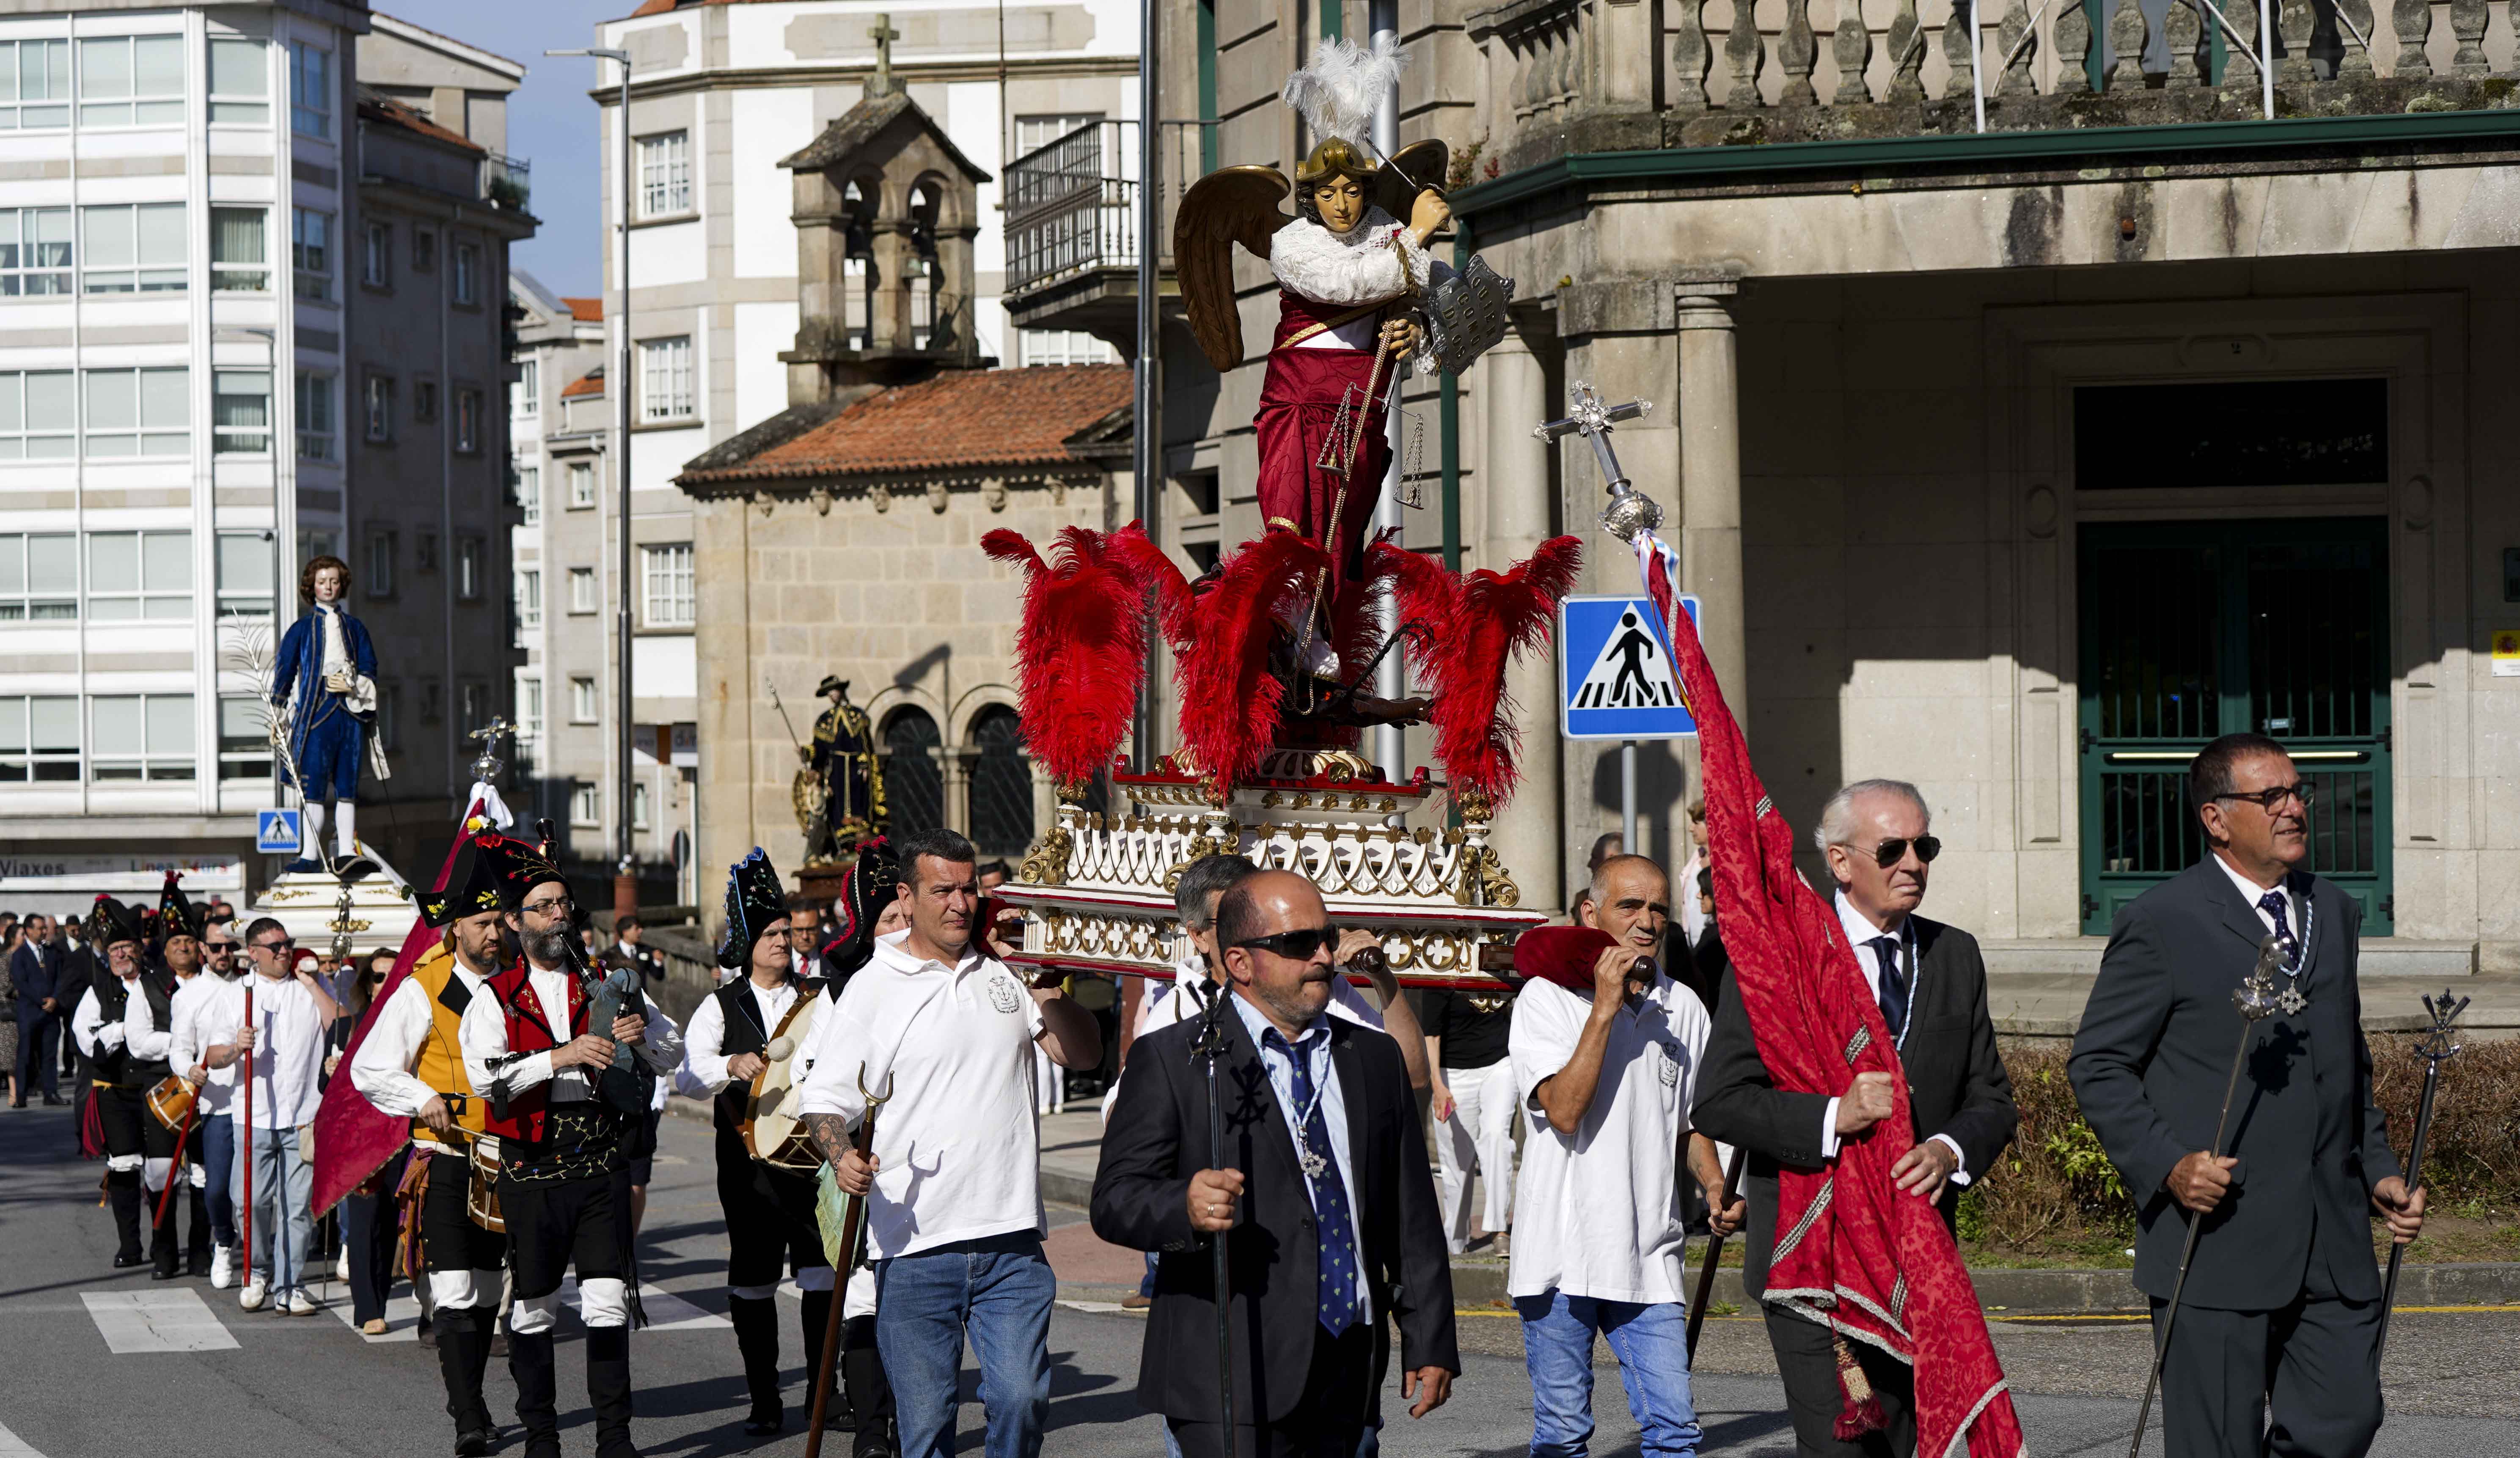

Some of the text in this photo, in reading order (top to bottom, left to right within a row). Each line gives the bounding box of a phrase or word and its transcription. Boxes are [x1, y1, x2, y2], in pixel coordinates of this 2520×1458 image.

[1442, 306, 1466, 359] DIOS
[1457, 292, 1480, 346] COMO
[0, 859, 66, 876] Viaxes
